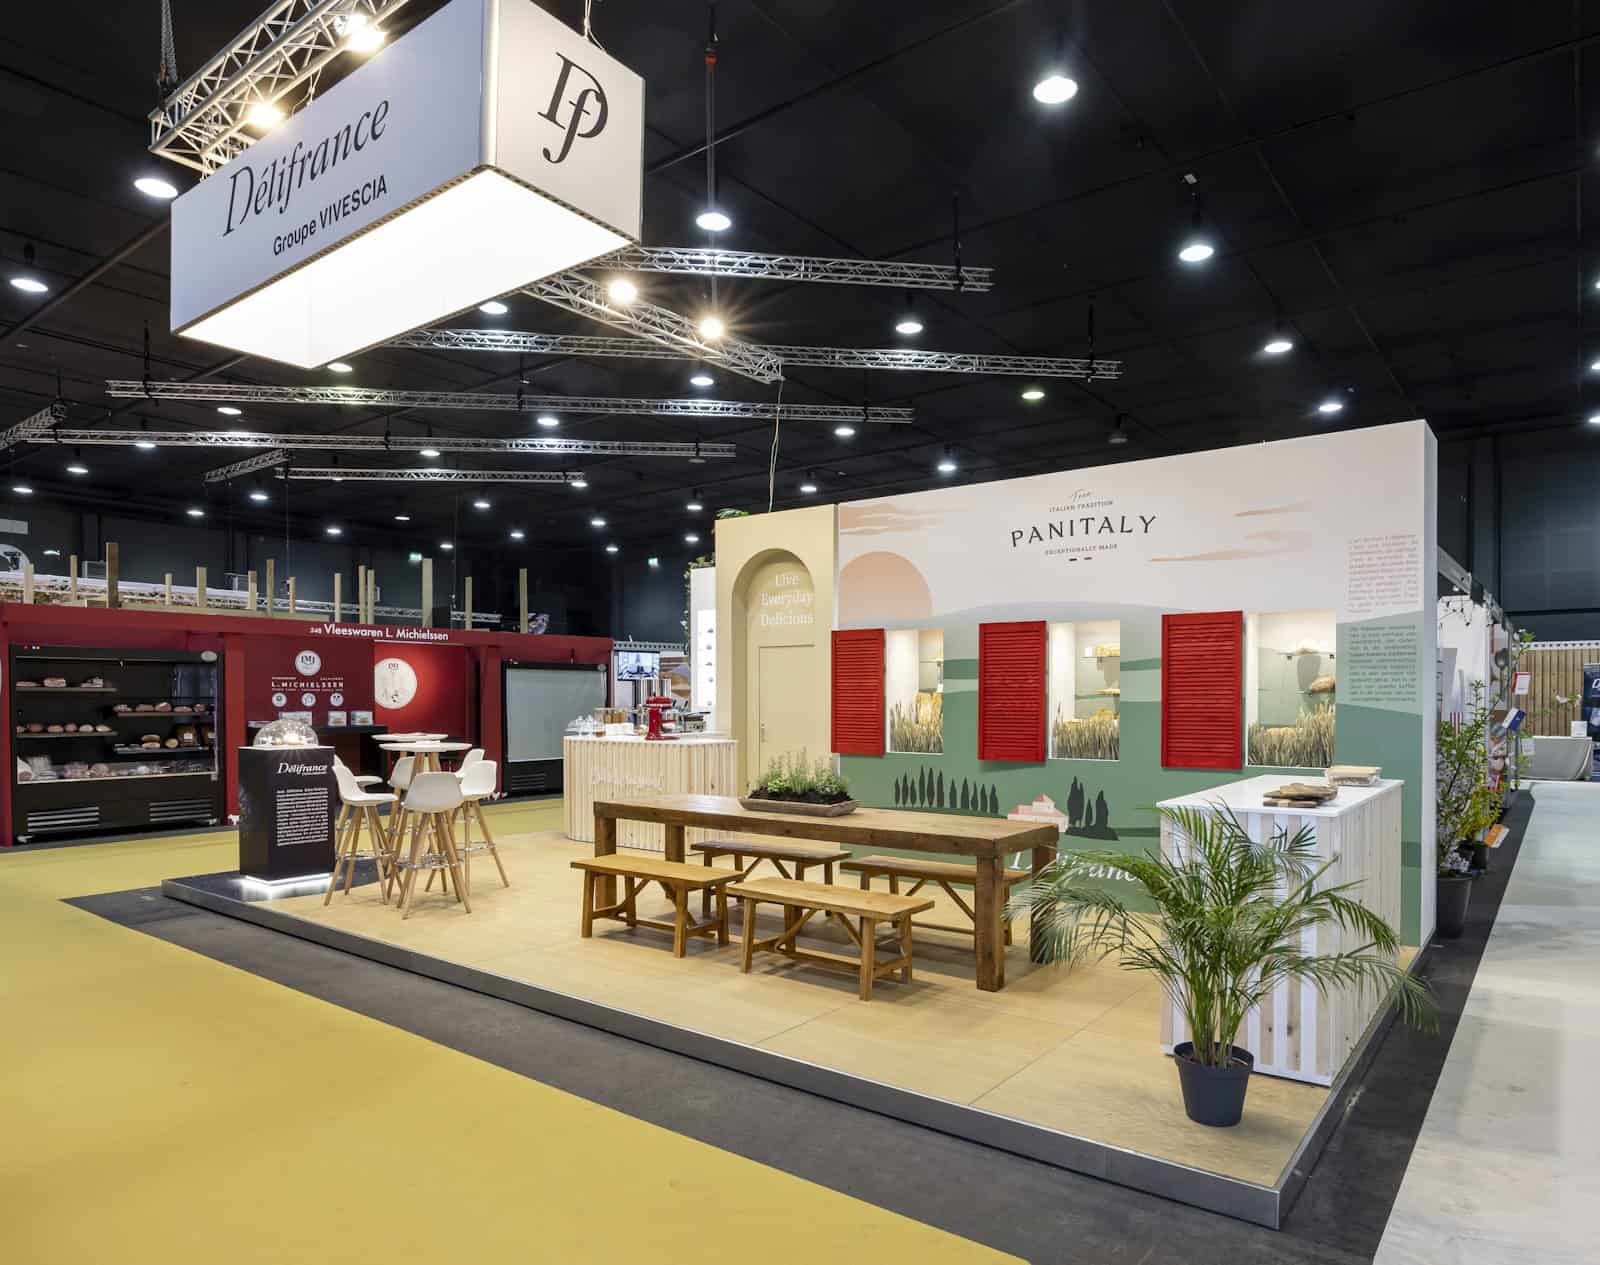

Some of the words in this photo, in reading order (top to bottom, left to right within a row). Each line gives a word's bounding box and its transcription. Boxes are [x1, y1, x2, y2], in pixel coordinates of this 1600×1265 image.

[222, 100, 389, 237] Délifrance
[273, 219, 317, 256] Groupe
[319, 174, 388, 229] VIVESCIA
[1011, 515, 1156, 547] PANITALY
[323, 623, 383, 637] Vleeswaren
[396, 627, 449, 640] Michielssen
